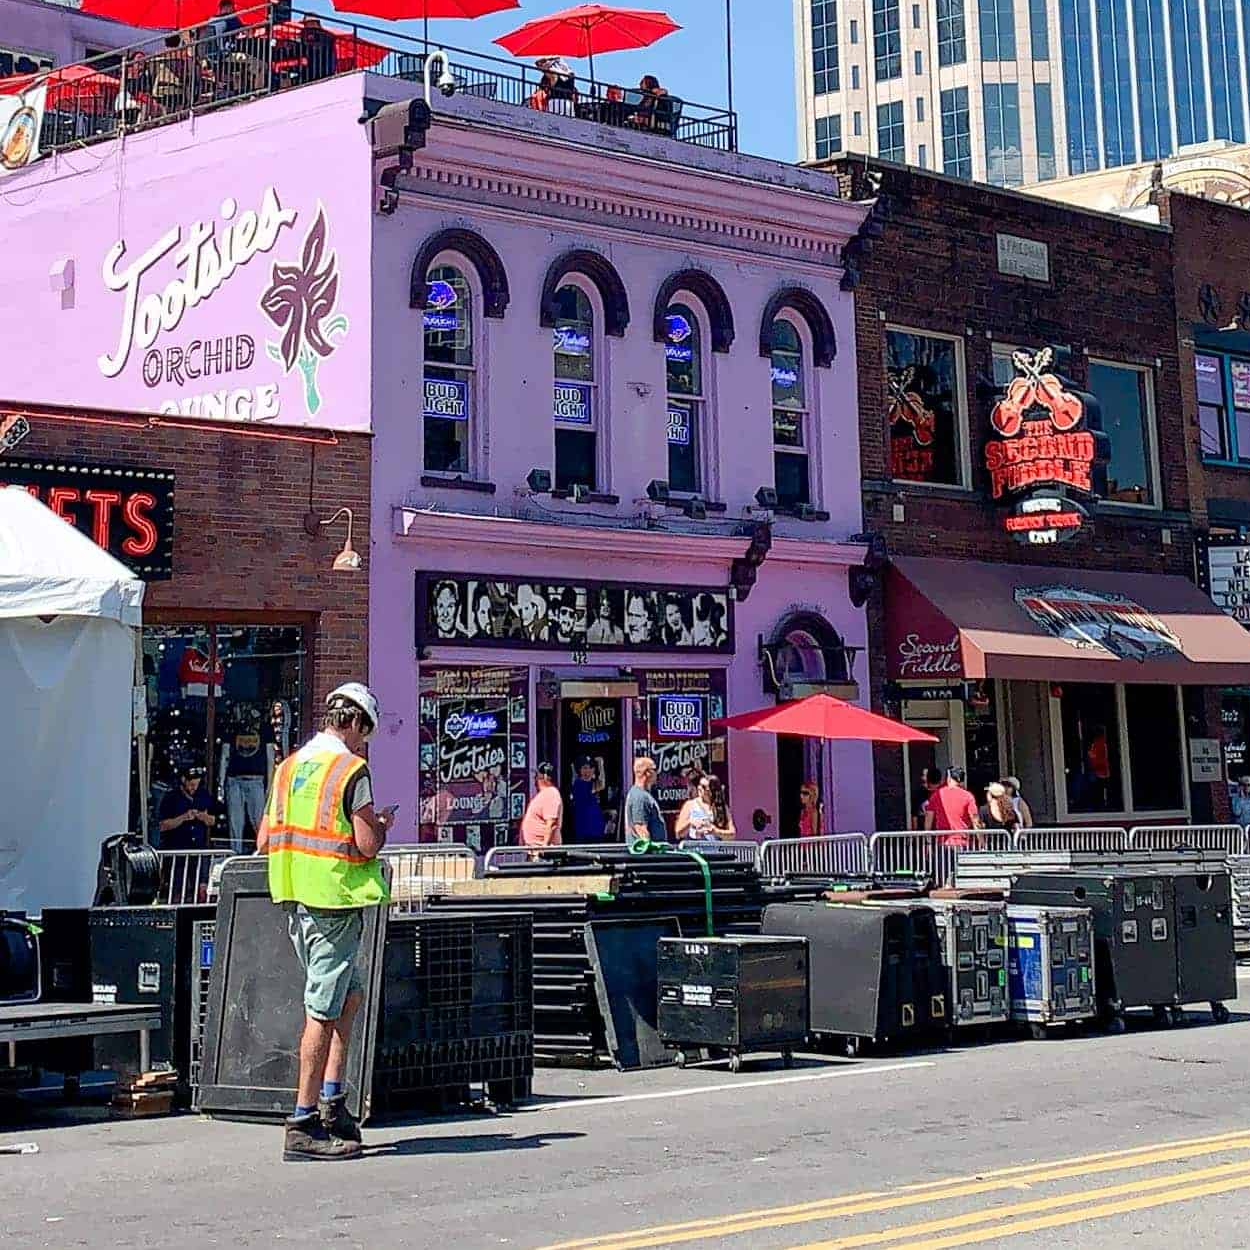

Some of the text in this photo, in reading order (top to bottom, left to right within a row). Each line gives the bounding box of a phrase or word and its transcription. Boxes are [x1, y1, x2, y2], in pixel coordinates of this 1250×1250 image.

[98, 184, 298, 379] Tootsies
[142, 334, 256, 389] ORCHID
[426, 381, 459, 400] BUD
[554, 387, 582, 403] BUD
[985, 432, 1095, 470] SECOND
[992, 460, 1091, 499] FIDDLE
[1228, 579, 1249, 592] NFL
[1224, 592, 1238, 605] TO
[898, 634, 960, 656] Second
[899, 653, 961, 676] Fiddle
[665, 701, 694, 716] BUD
[661, 716, 700, 732] LIGHT
[440, 743, 506, 783] Tootsies
[651, 741, 708, 774] Tootsies
[658, 788, 690, 801] LOUNG
